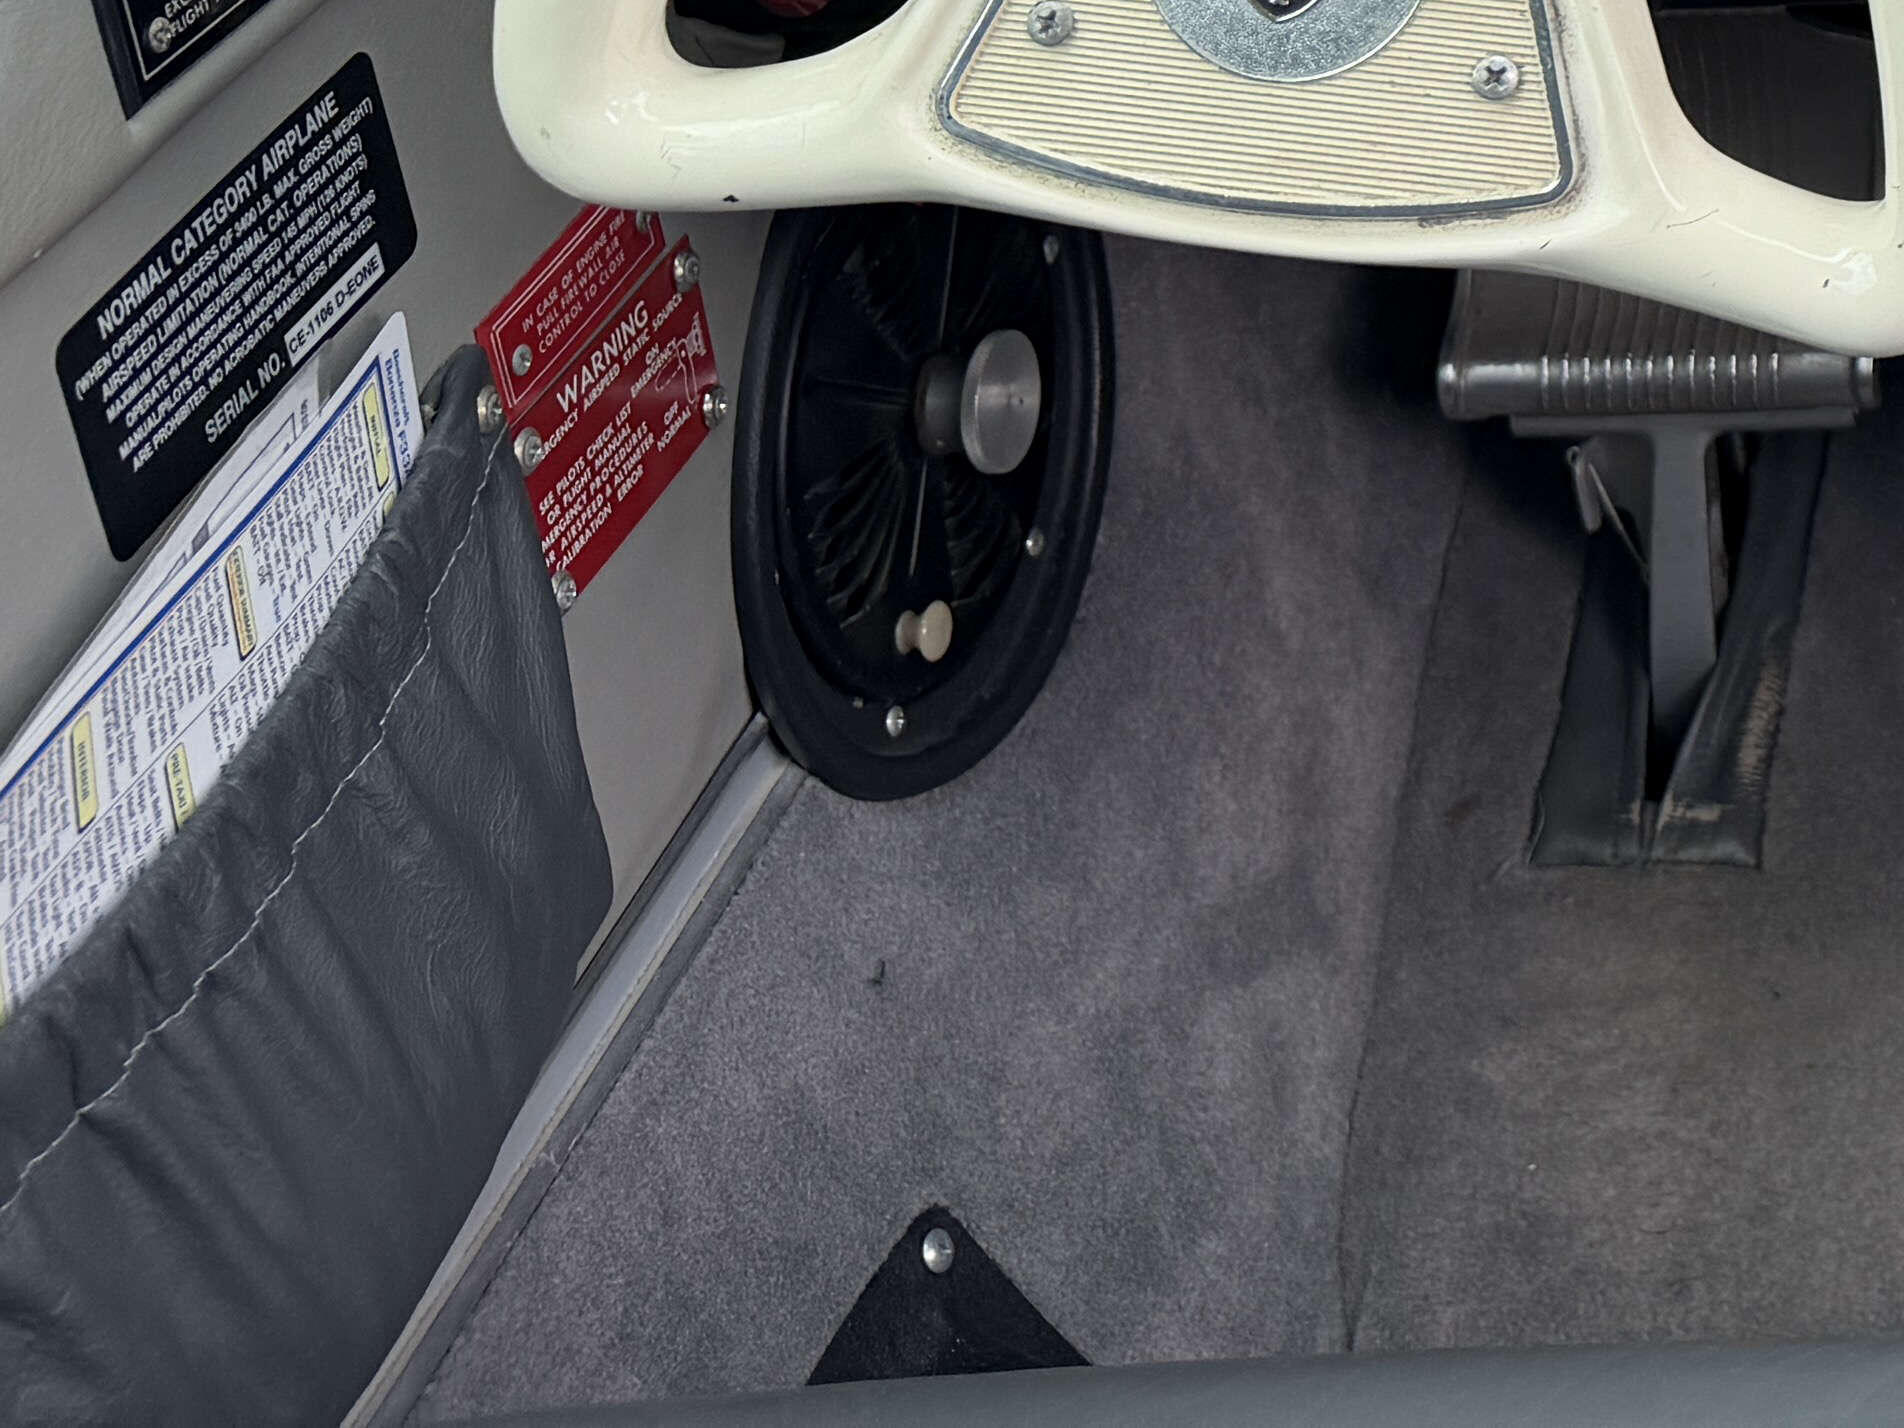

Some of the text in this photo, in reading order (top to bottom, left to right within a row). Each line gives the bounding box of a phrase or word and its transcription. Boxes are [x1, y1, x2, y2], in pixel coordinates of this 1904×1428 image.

[96, 91, 340, 340] NORMAL CATEGORY AIRPLANE
[203, 361, 286, 443] SERIAL NO.
[554, 300, 650, 413] WARNING
